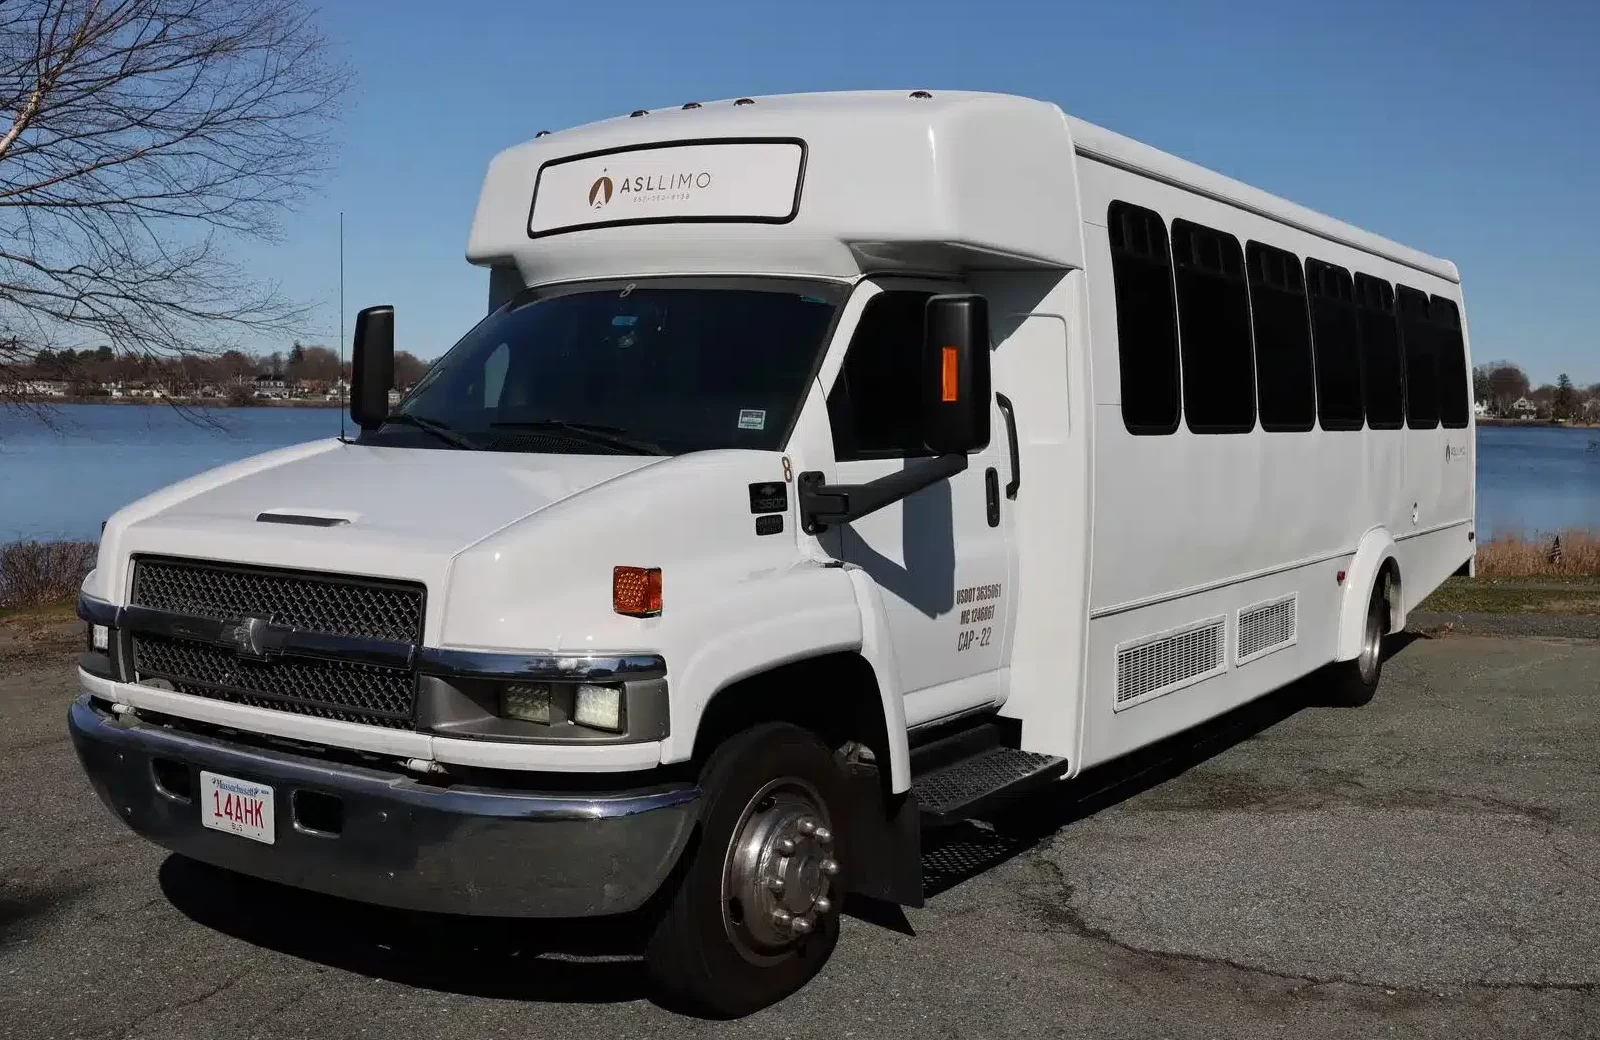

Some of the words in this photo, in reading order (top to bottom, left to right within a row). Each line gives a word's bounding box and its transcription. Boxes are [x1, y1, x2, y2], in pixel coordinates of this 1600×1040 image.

[620, 172, 711, 194] ASLLIMO
[781, 456, 793, 483] 8
[956, 587, 976, 605] USDOT
[960, 609, 971, 625] MC
[958, 630, 975, 652] CAP
[980, 627, 992, 647] 22
[214, 789, 264, 829] 14AHK
